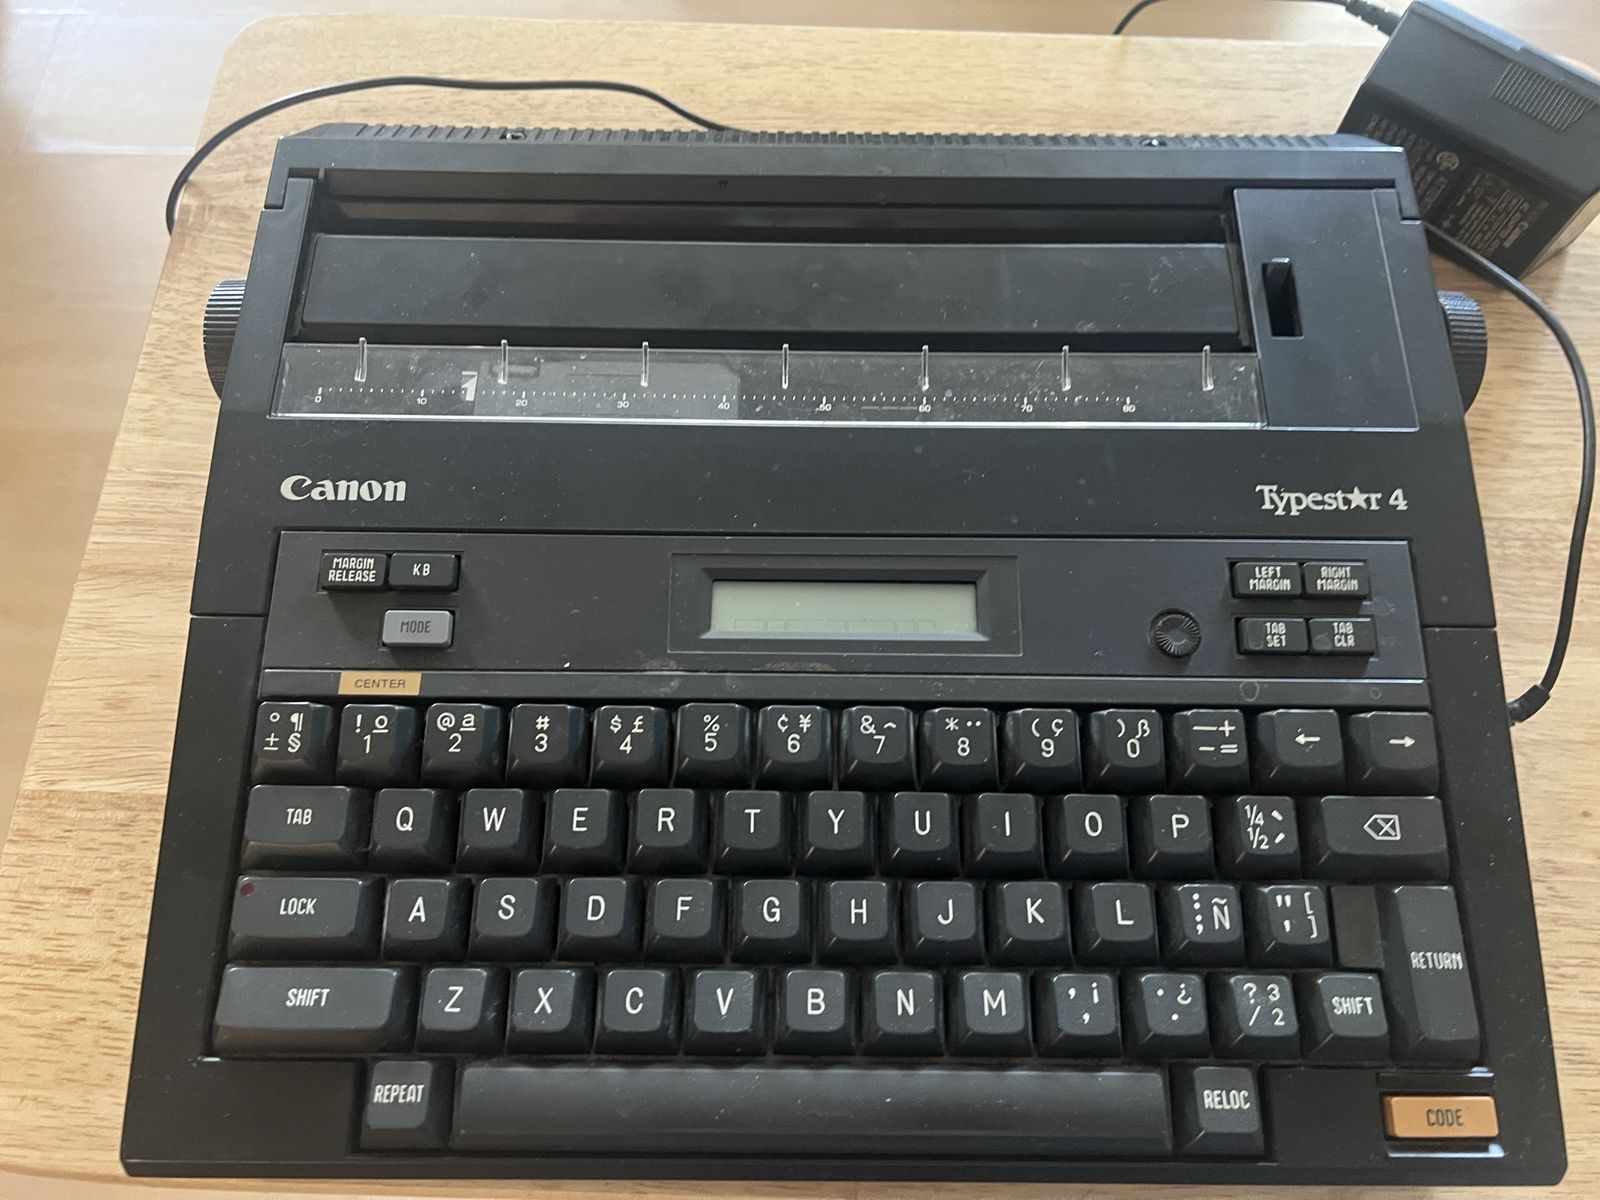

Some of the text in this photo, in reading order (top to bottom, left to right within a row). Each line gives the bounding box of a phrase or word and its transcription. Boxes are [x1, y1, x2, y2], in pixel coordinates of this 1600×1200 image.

[416, 398, 428, 406] 10
[616, 399, 630, 409] 30
[717, 401, 731, 410] 40
[1020, 404, 1034, 413] 70
[281, 475, 406, 501] Canon
[1389, 489, 1407, 510] 4
[332, 557, 375, 570] MARGIN
[413, 564, 430, 576] KB
[1255, 566, 1281, 578] LEFT
[1321, 566, 1351, 578] RIGHT
[328, 569, 377, 582] RELEASE
[1249, 578, 1291, 591] MARGIN
[1316, 578, 1359, 591] MARGIN
[401, 621, 431, 633] MODE
[1264, 622, 1286, 635] TAB
[1332, 621, 1356, 634] TAB
[1267, 635, 1285, 647] SET
[1334, 634, 1355, 647] CLR
[354, 678, 406, 689] CENTER
[356, 714, 362, 732] !
[437, 713, 455, 731] @
[536, 716, 549, 730] #
[610, 715, 643, 733] $ £
[704, 715, 719, 731] %
[778, 714, 811, 732] ¢ ¥
[861, 715, 876, 734] &
[1032, 719, 1039, 737] (
[1117, 719, 1150, 738] ) ß
[1219, 720, 1235, 736] +
[288, 734, 301, 752] §
[364, 736, 370, 753] 1
[449, 734, 461, 752] 2
[535, 734, 547, 752] 3
[620, 735, 632, 753] 4
[705, 733, 717, 751] 5
[788, 734, 800, 753] 6
[874, 736, 885, 754] 7
[958, 737, 970, 756] 8
[1042, 739, 1054, 757] 9
[1127, 737, 1139, 757] 0
[1219, 744, 1239, 754] =
[287, 809, 312, 824] TAB
[396, 807, 413, 831] Q
[484, 807, 506, 831] W
[573, 808, 588, 831] E
[658, 808, 674, 831] R
[745, 809, 760, 833] T
[828, 809, 844, 834] Y
[915, 810, 930, 835] U
[1005, 812, 1010, 836] I
[1172, 815, 1189, 838] P
[280, 898, 316, 914] LOCK
[409, 897, 425, 922] A
[498, 895, 515, 919] S
[587, 896, 605, 920] D
[677, 897, 692, 920] F
[763, 897, 780, 922] G
[851, 899, 866, 924] H
[938, 899, 953, 924] J
[1027, 899, 1044, 923] K
[1116, 900, 1134, 925] L
[1212, 898, 1230, 929] Ñ
[1411, 952, 1463, 969] RETURN
[286, 989, 330, 1006] SHIFT
[444, 986, 463, 1012] Z
[534, 988, 553, 1013] X
[626, 987, 643, 1014] C
[717, 988, 733, 1015] V
[808, 988, 825, 1014] B
[897, 989, 914, 1015] N
[1177, 984, 1191, 1004] ¿
[1243, 983, 1280, 1004] ? 3
[983, 990, 1006, 1016] M
[1332, 997, 1372, 1014] SHIFT
[1272, 1008, 1284, 1025] 2
[374, 1085, 424, 1103] REPEAT
[1204, 1090, 1250, 1109] RELOC
[1426, 1109, 1463, 1126] CODE
